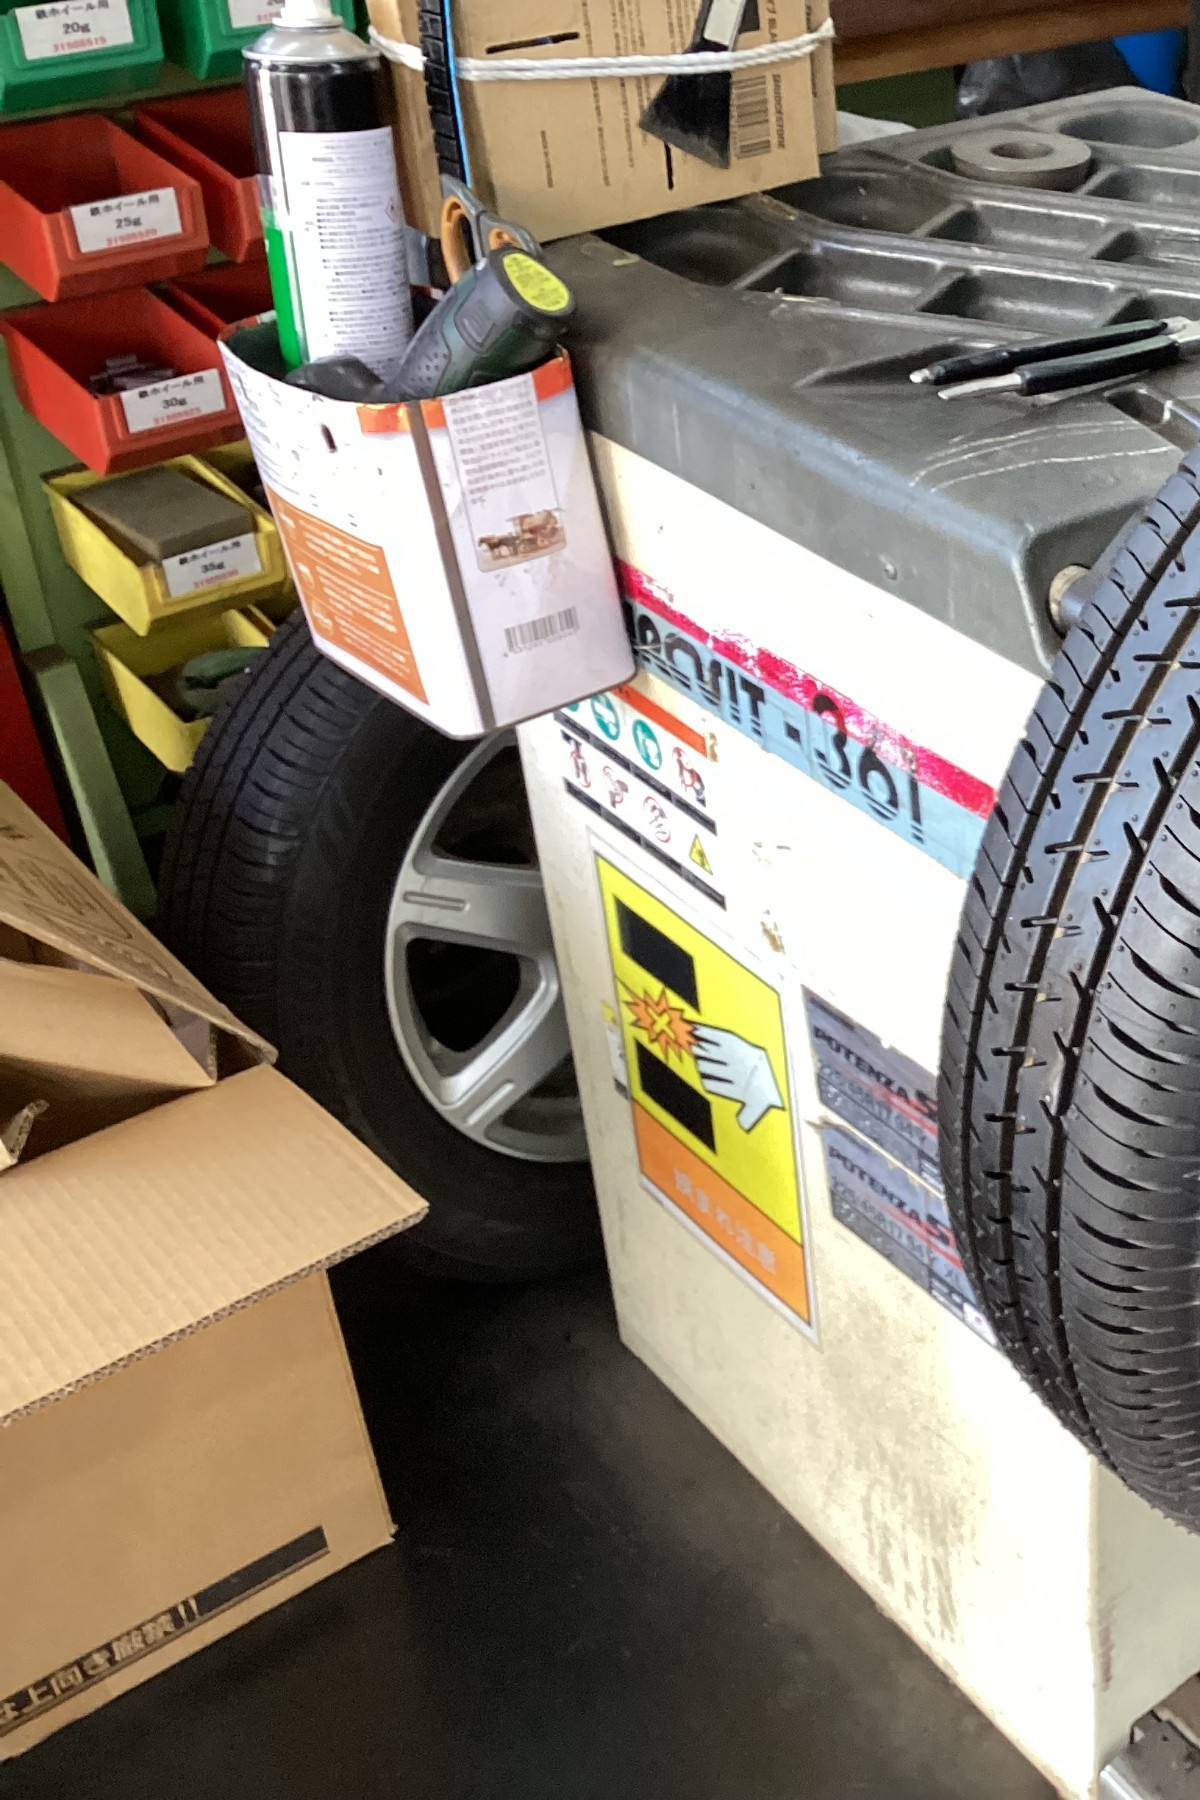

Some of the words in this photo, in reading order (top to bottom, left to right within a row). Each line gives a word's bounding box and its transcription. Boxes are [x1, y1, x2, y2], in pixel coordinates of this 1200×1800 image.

[63, 22, 91, 34] 20g
[115, 216, 142, 229] 25g
[162, 396, 188, 410] 30g
[813, 1025, 911, 1104] POTENZA
[829, 1146, 923, 1226] POTENZA
